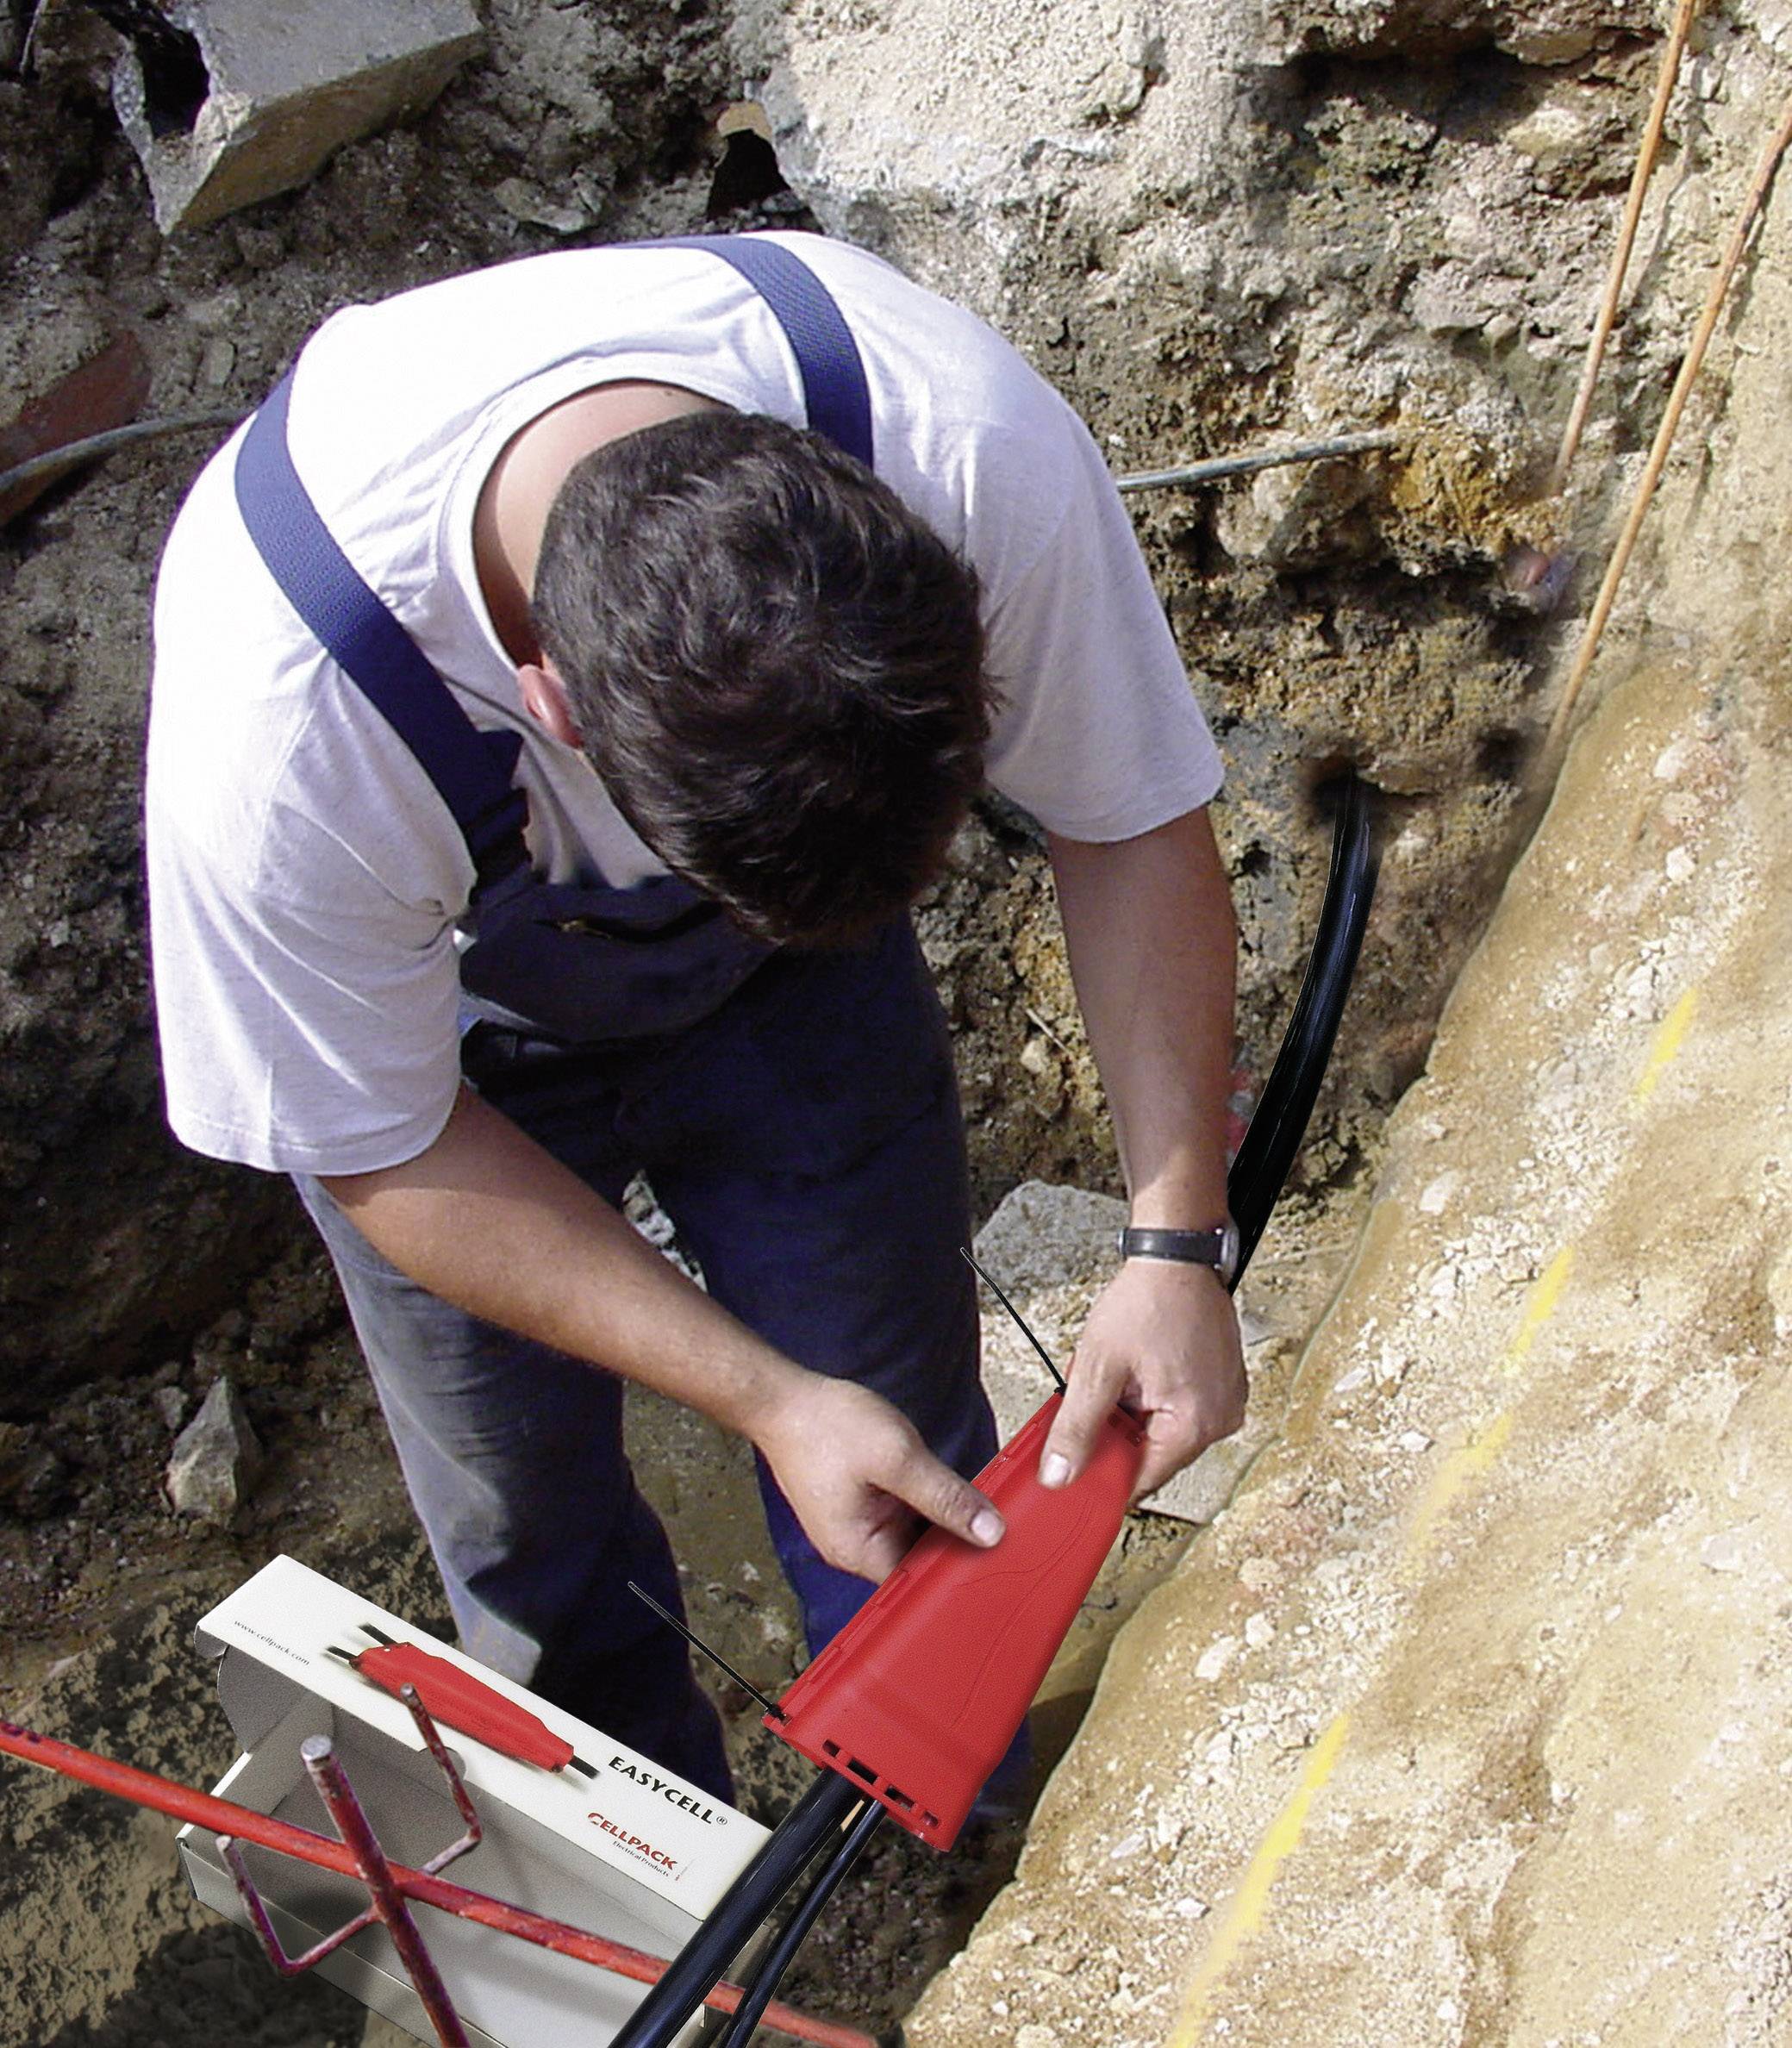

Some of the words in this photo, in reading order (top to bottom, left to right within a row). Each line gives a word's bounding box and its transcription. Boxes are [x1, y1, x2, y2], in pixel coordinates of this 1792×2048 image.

[234, 1620, 310, 1665] www.cellpack.com
[587, 1812, 678, 1870] CELLPACK
[612, 1840, 642, 1861] Electrical
[640, 1857, 670, 1877] Products
